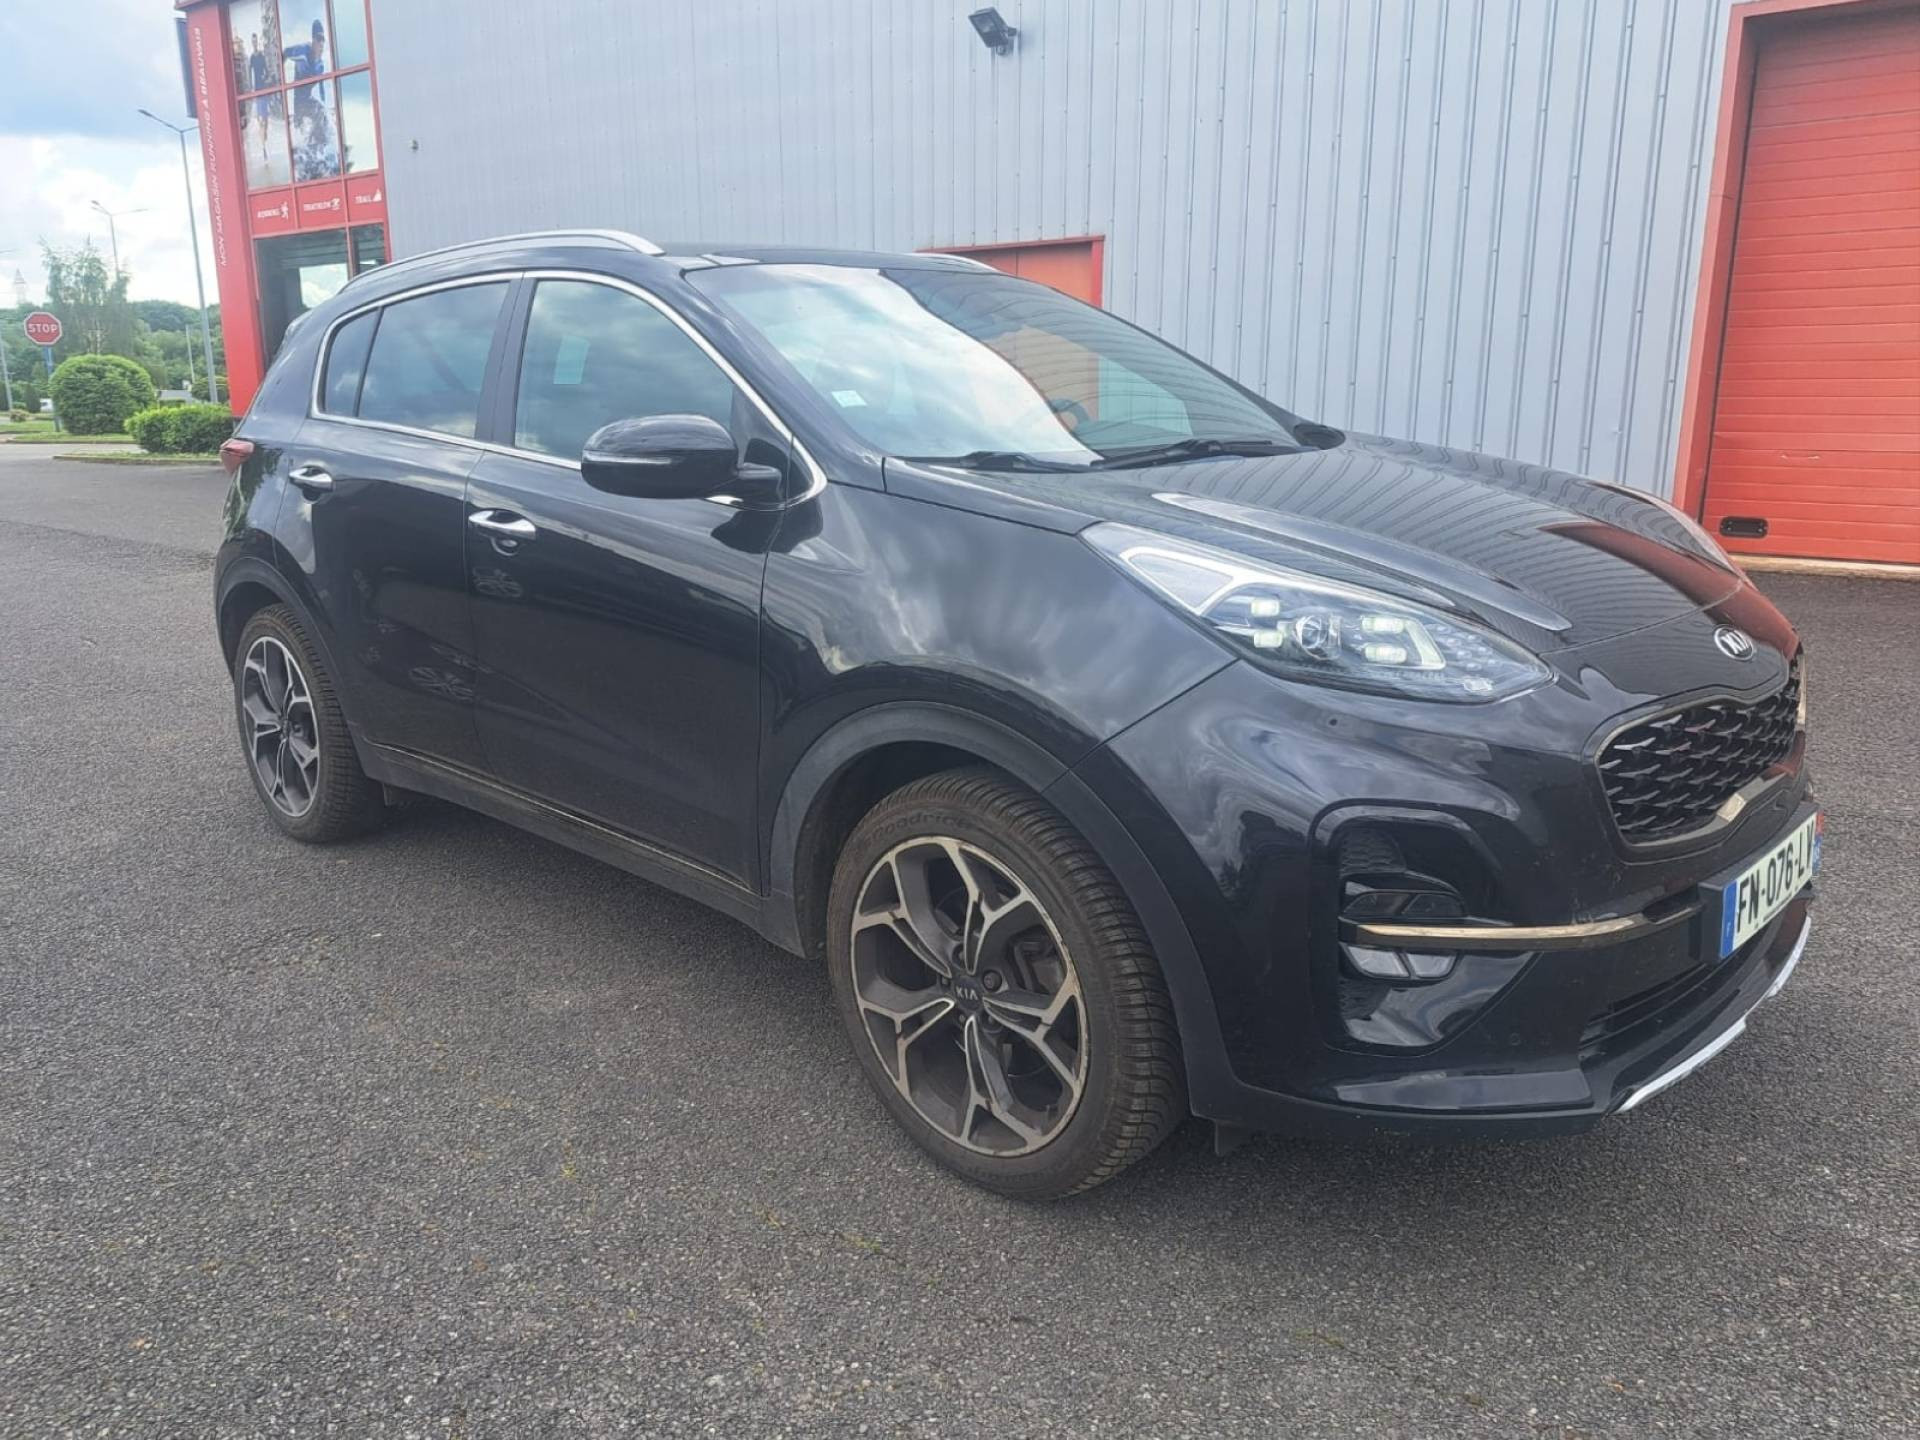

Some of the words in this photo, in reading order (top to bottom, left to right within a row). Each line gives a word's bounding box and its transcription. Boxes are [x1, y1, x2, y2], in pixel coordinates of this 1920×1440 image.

[194, 27, 208, 95] BEAUVAIS
[204, 109, 217, 172] RUNNING
[211, 175, 224, 233] MAGASIN
[219, 235, 227, 267] MON
[28, 323, 58, 334] STOP
[955, 985, 979, 1000] KIA
